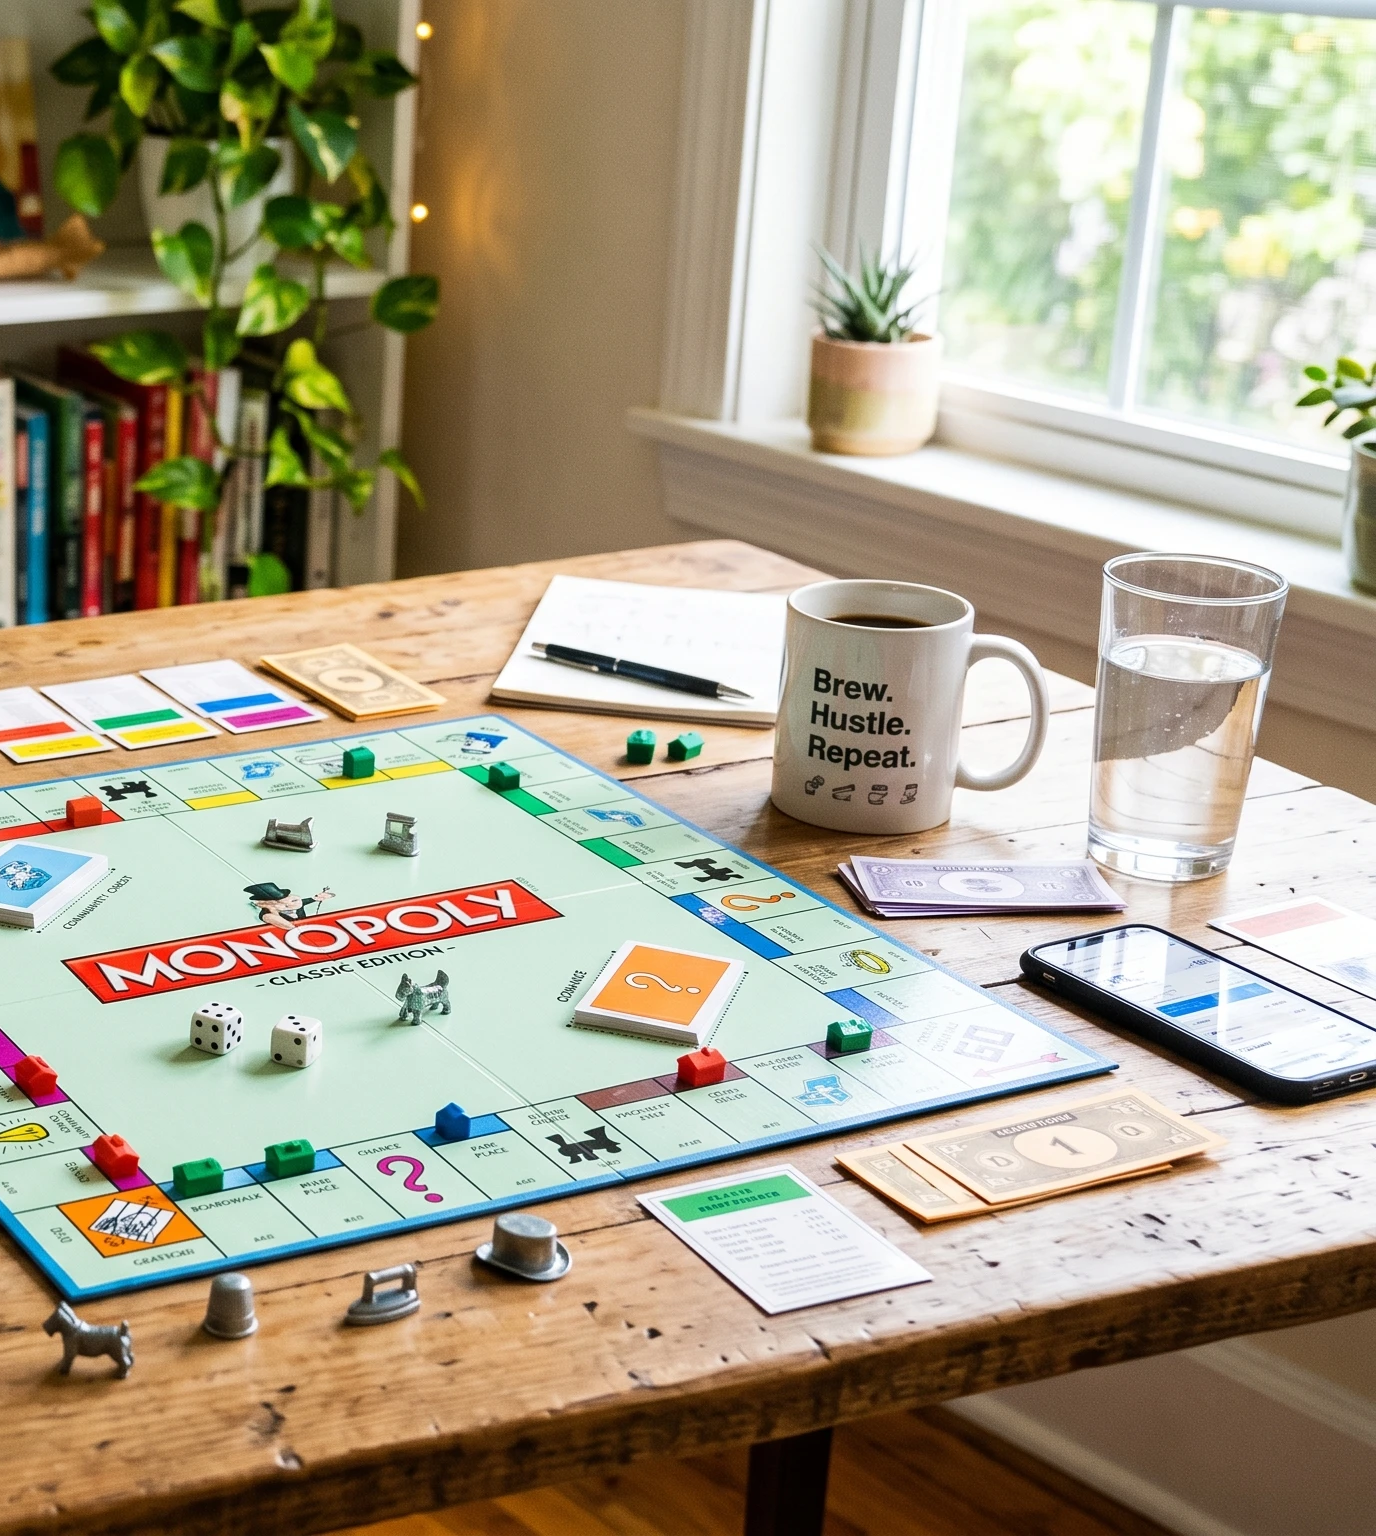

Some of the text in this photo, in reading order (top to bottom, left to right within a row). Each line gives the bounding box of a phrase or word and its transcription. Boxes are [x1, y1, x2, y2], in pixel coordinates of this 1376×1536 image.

[813, 667, 893, 702] Brew.
[810, 700, 911, 735] Hustle.
[808, 734, 916, 771] Repeat.
[96, 889, 518, 993] MONOPOLY
[269, 945, 445, 987] CLASSIC EDITION
